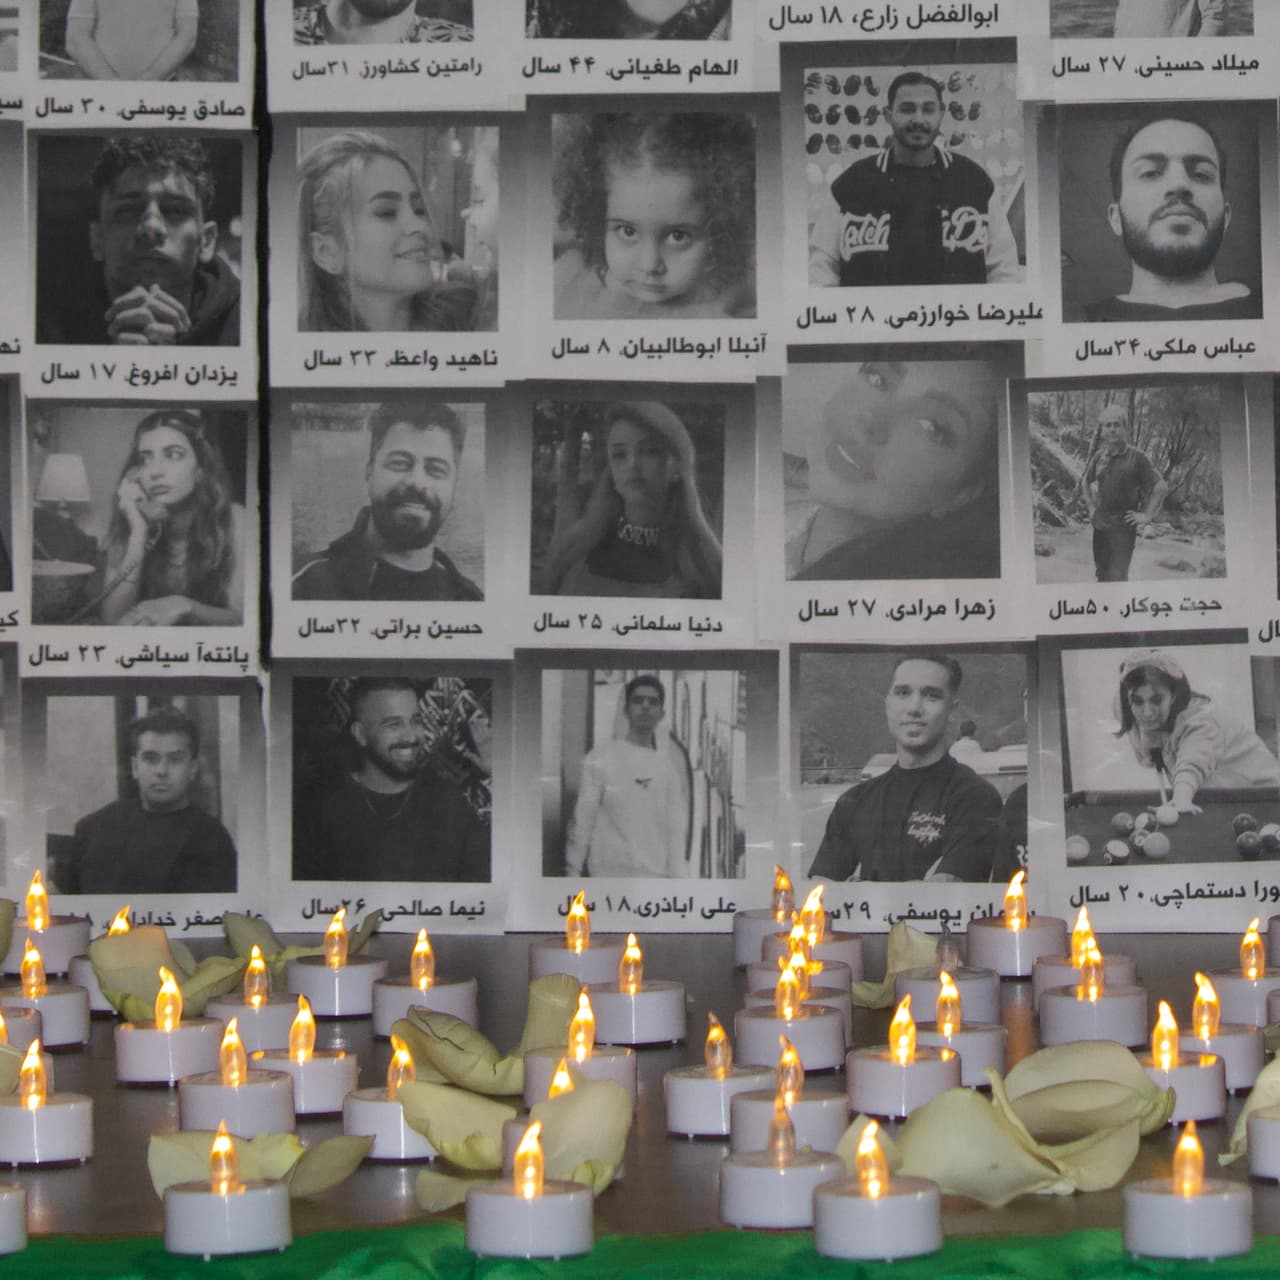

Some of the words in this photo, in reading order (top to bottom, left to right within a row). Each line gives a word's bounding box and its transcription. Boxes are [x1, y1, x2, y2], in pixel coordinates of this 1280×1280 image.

[770, 5, 813, 30] سال
[820, 6, 843, 24] ۱۸
[906, 3, 997, 30] ابوالفضل
[522, 57, 561, 78] سال
[689, 59, 738, 83] الهام
[1052, 57, 1090, 78] سال
[1099, 56, 1125, 72] ۲۷
[1212, 54, 1259, 75] میلاد
[35, 97, 73, 118] سال
[193, 100, 245, 121] صادق
[797, 307, 837, 329] سال
[846, 306, 874, 323] ۲۸
[552, 338, 590, 359] سال
[598, 338, 610, 353] ۸
[41, 363, 80, 384] سال
[90, 364, 116, 379] ۱۷
[185, 365, 238, 386] یزدان
[799, 600, 838, 622] سال
[848, 599, 876, 616] ۲۷
[955, 598, 995, 621] زهرا
[534, 613, 570, 632] سال
[578, 614, 602, 629] ۲۵
[689, 616, 722, 632] دنیا
[29, 644, 69, 667] سال
[1070, 885, 1110, 908] سال
[1119, 885, 1144, 901] ۲۰
[701, 897, 736, 919] علی
